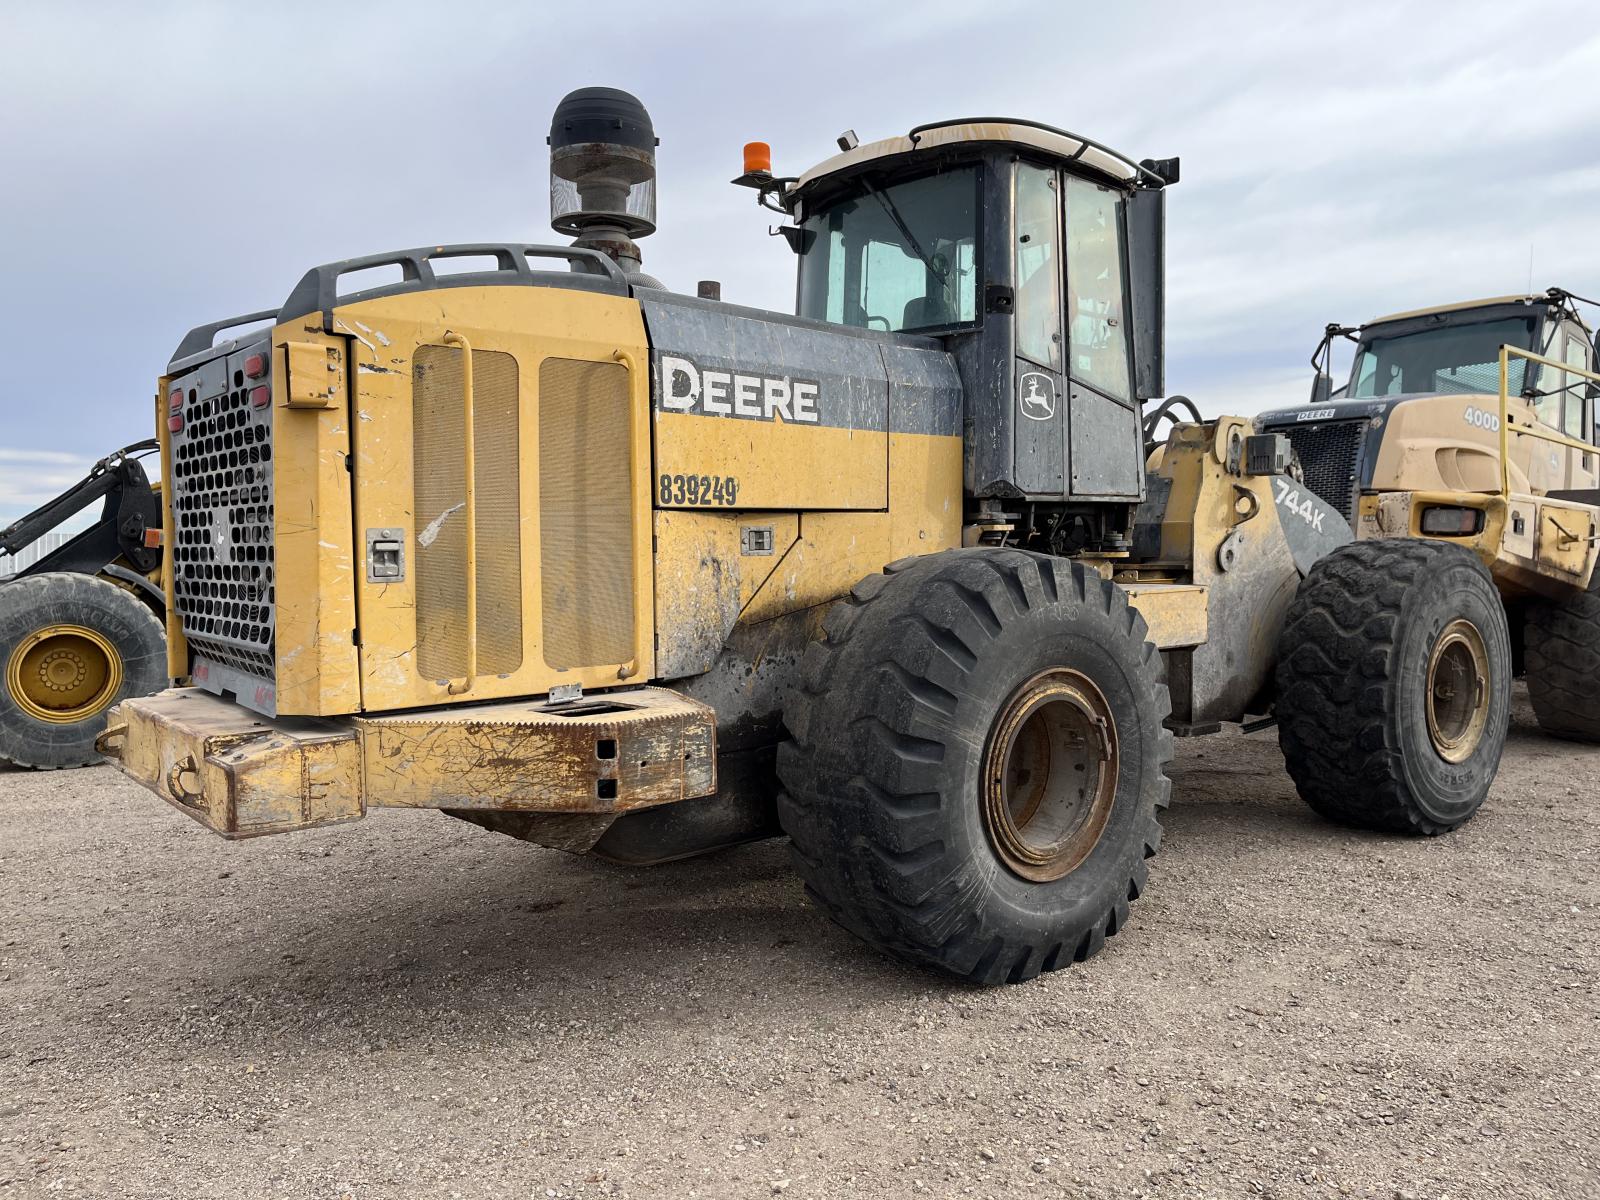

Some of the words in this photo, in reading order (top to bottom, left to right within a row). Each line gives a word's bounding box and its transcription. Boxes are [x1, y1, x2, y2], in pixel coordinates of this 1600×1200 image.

[662, 356, 818, 422] DEERE
[1298, 409, 1335, 420] DEERE
[1464, 406, 1500, 432] 400D
[660, 474, 738, 505] 839249
[1275, 478, 1325, 534] 744K
